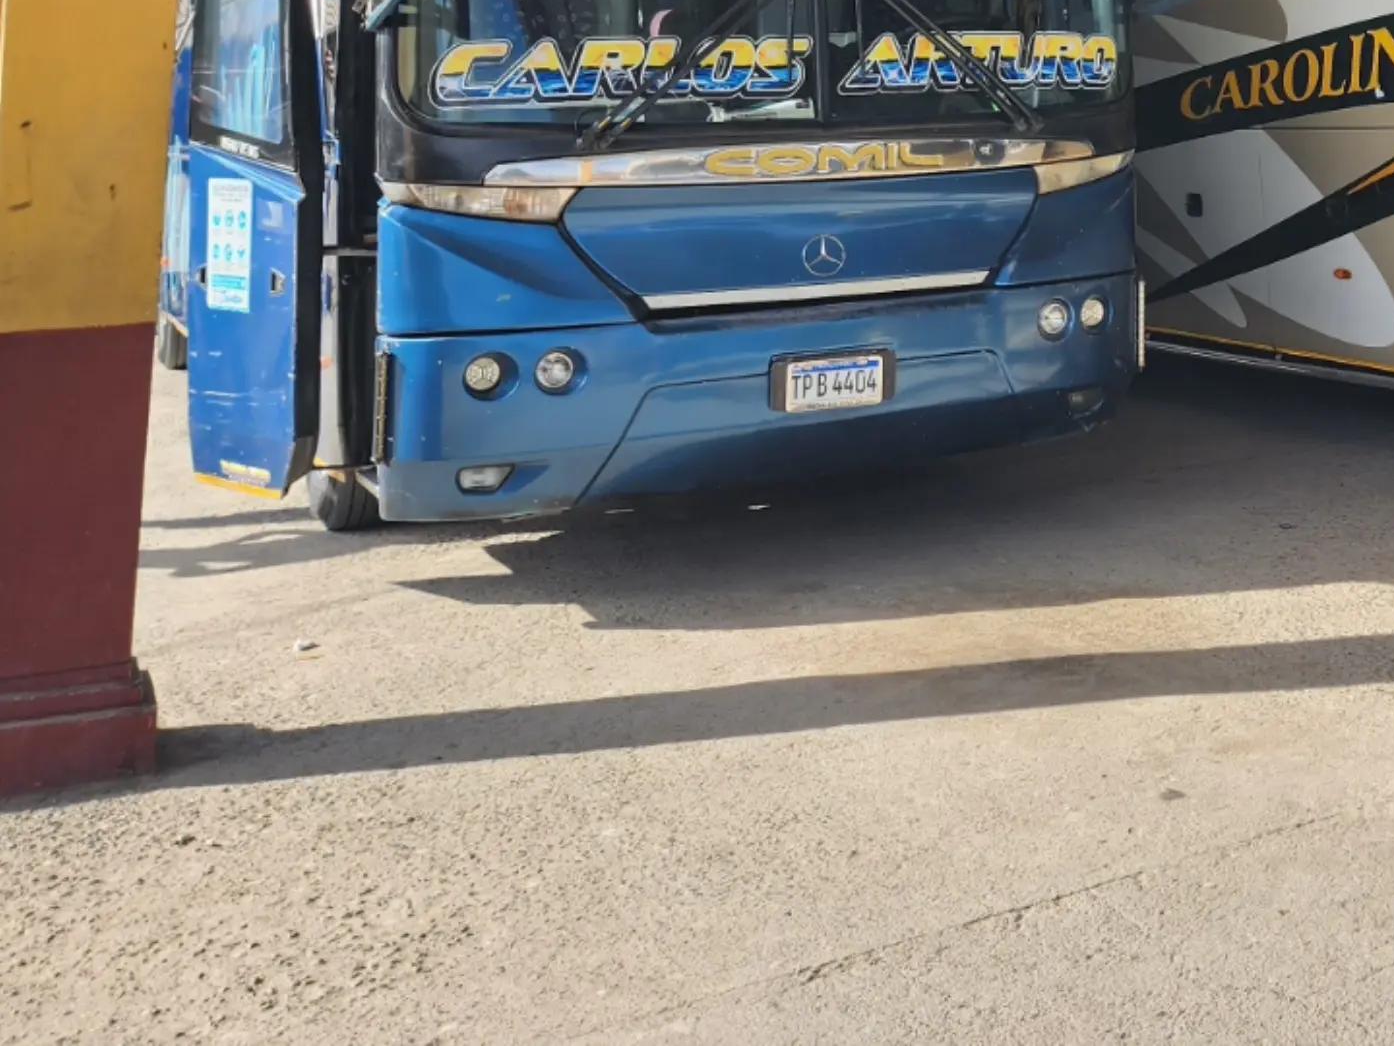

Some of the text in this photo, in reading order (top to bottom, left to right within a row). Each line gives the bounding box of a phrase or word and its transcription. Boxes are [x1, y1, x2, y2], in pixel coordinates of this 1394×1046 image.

[431, 30, 1118, 108] CARLOS ARTURO
[704, 141, 943, 177] COMIL
